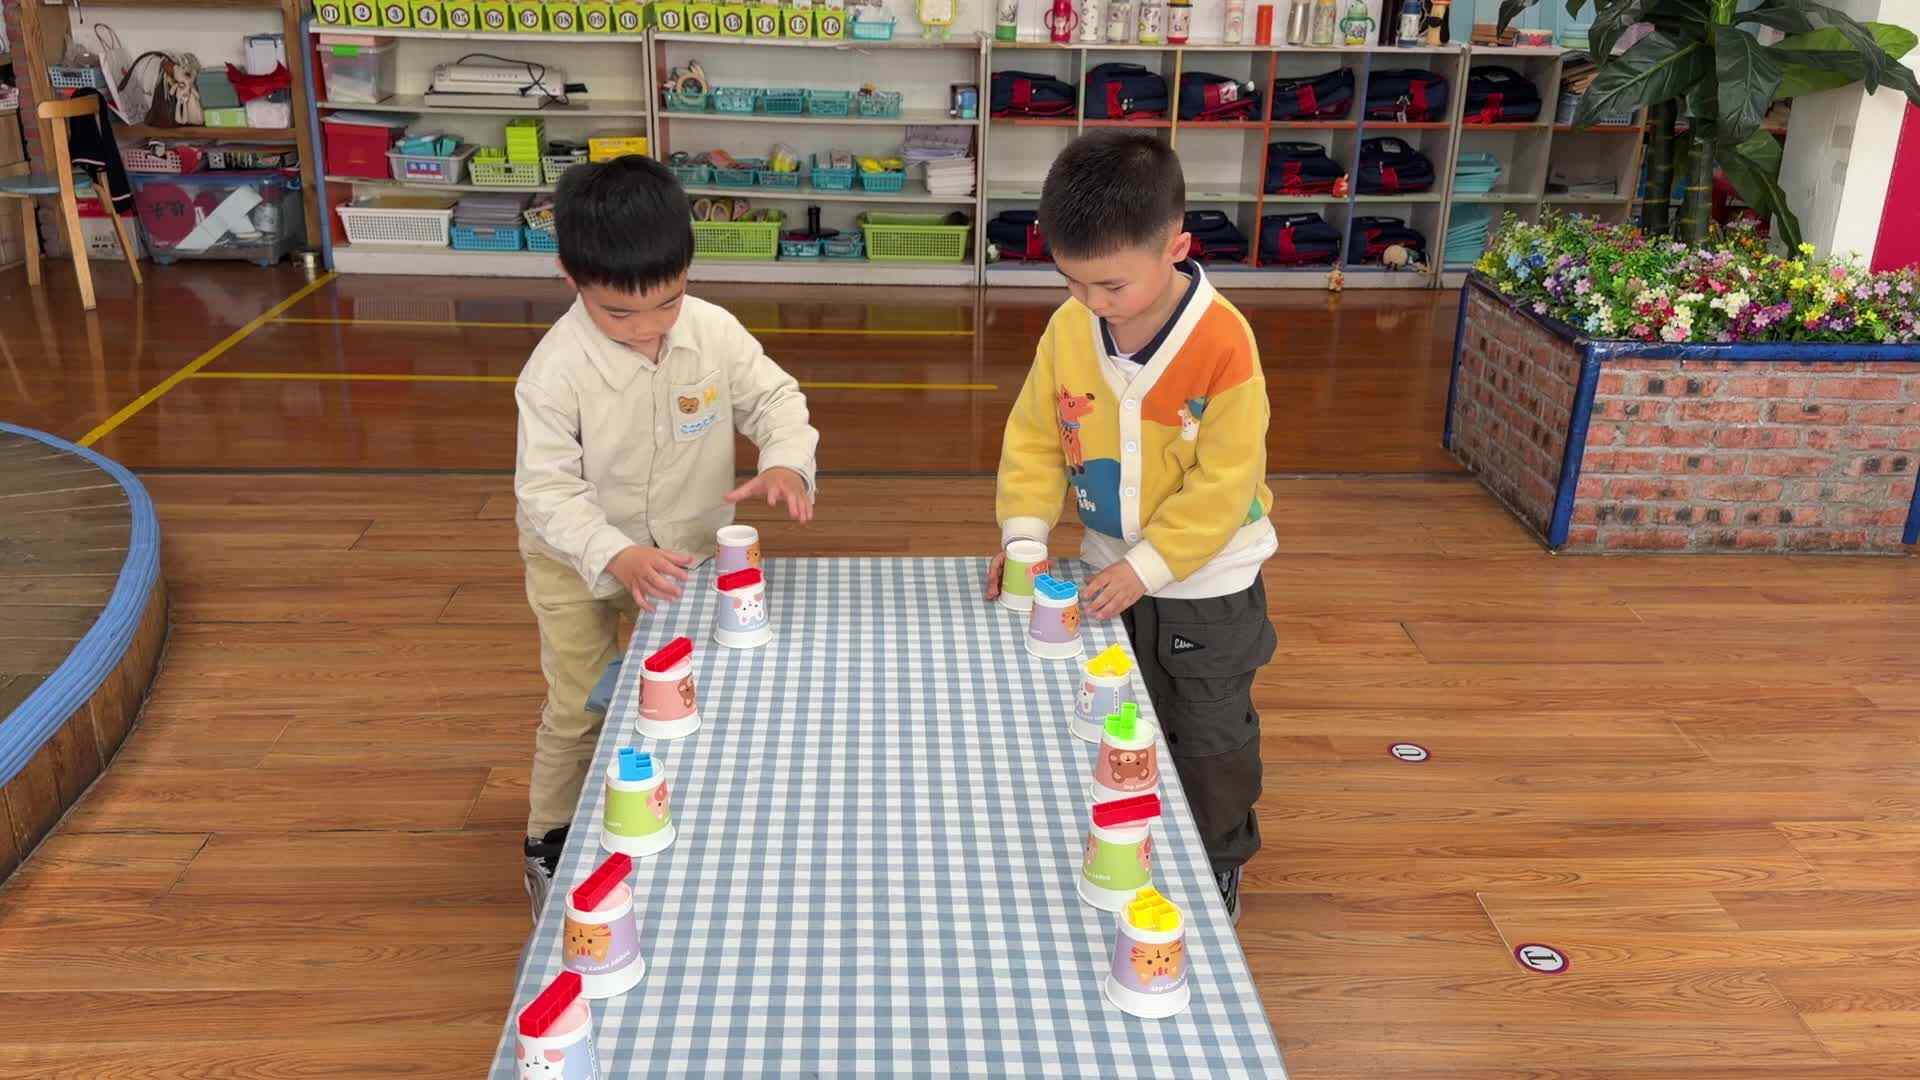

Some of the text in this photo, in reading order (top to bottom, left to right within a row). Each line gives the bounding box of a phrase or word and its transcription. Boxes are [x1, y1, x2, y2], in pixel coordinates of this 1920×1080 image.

[557, 14, 570, 25] 08
[590, 14, 603, 25] 09
[623, 15, 635, 26] 10
[665, 14, 676, 26] 11
[695, 15, 707, 27] 12
[760, 19, 772, 31] 14
[825, 20, 837, 32] 16
